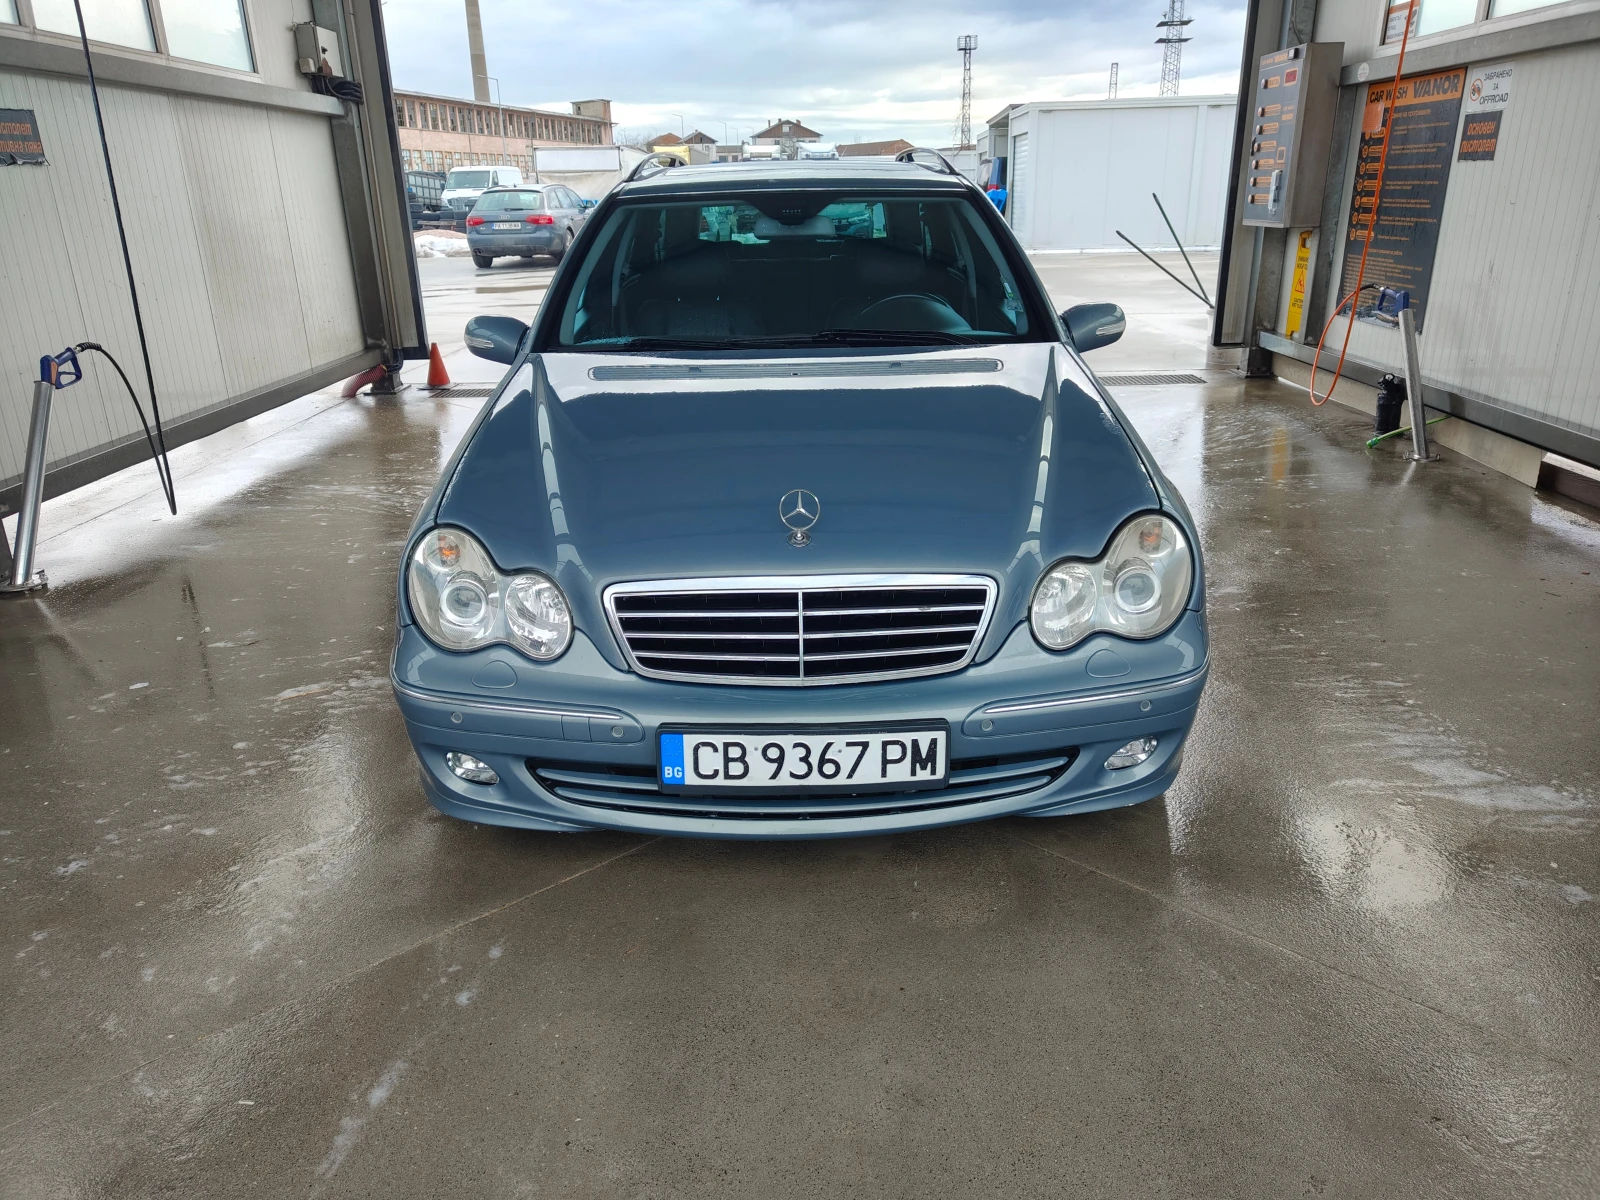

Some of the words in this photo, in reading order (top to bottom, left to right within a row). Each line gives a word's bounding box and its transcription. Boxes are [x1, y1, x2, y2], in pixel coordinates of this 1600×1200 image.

[1484, 69, 1513, 81] ЗАБРАНЕНО
[1370, 90, 1384, 103] CAR
[1385, 86, 1408, 101] WSH
[1413, 74, 1461, 99] VIANOR
[1480, 93, 1509, 105] OFFROAD
[693, 741, 750, 780] CB
[761, 740, 870, 780] 9367
[880, 737, 939, 778] PM
[664, 766, 683, 779] BG
